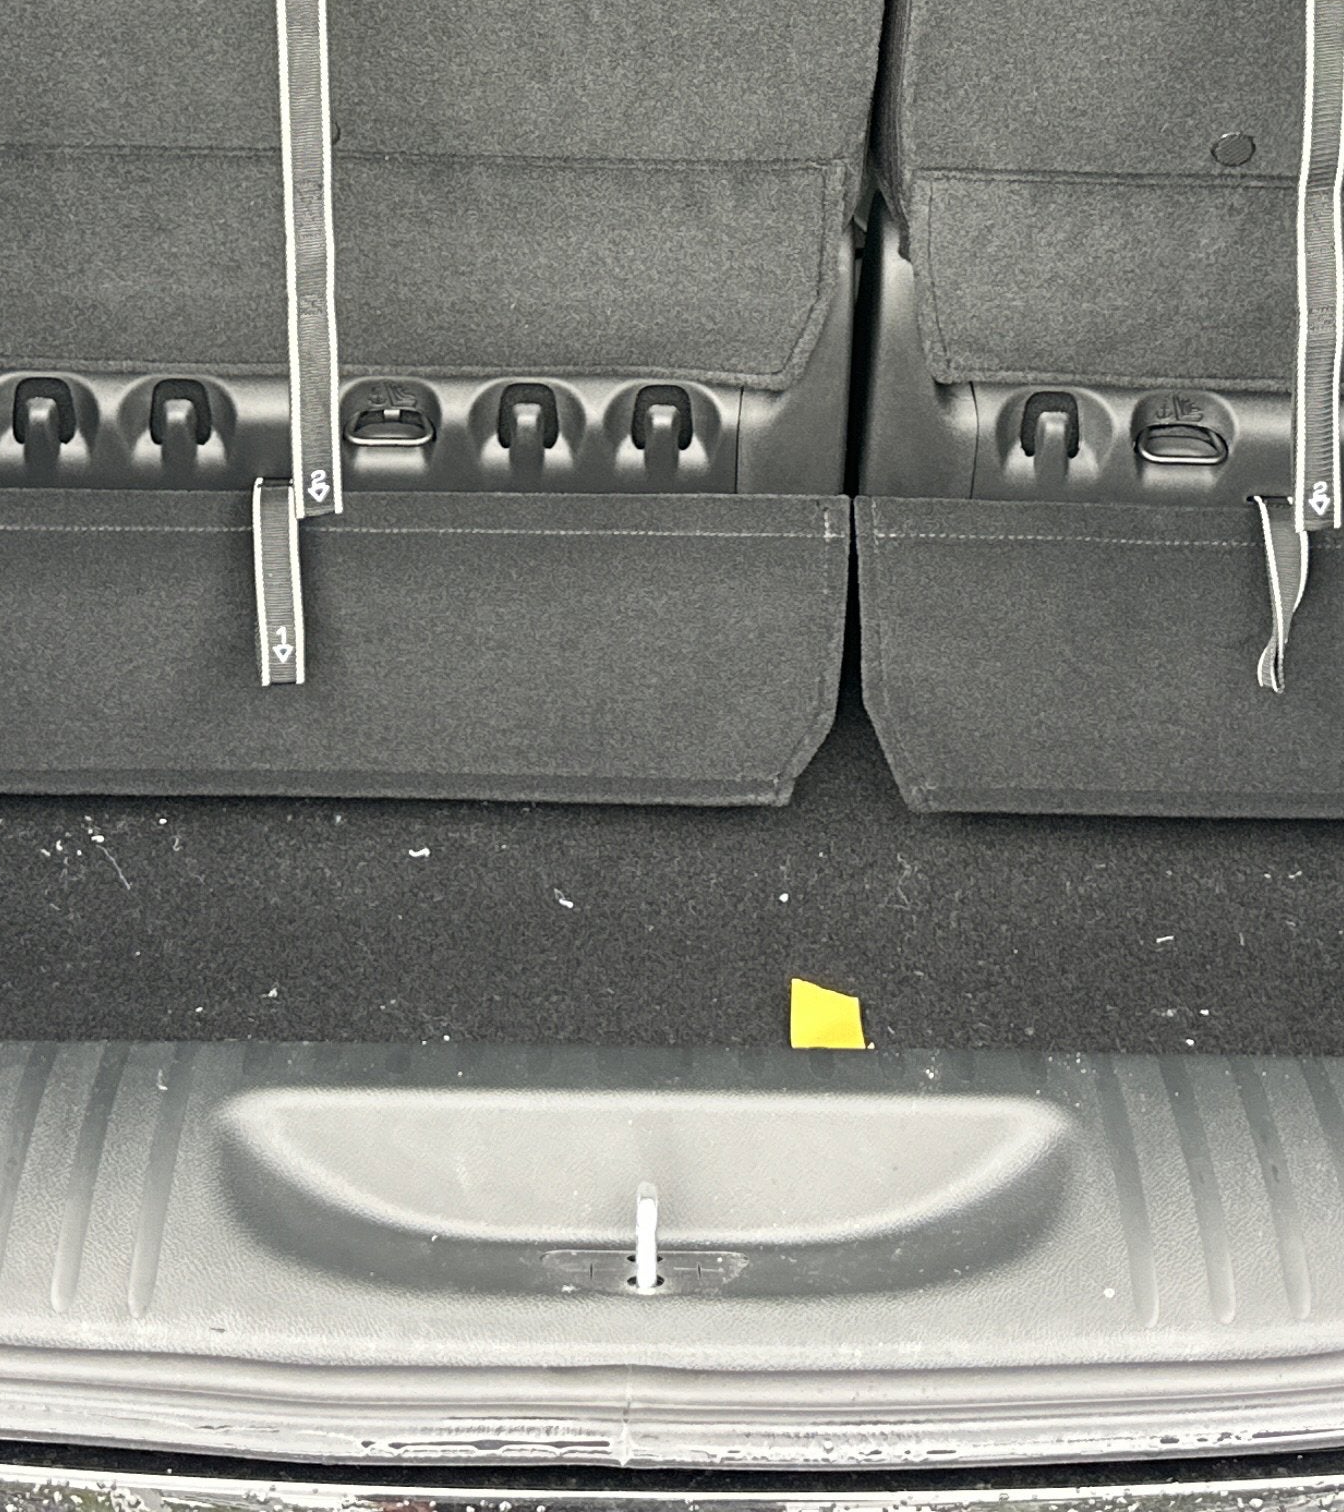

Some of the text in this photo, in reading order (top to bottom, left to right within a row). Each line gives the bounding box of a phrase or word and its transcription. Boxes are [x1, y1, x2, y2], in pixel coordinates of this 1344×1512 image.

[311, 469, 326, 486] 2
[1313, 481, 1327, 498] 2
[276, 626, 287, 645] 1
